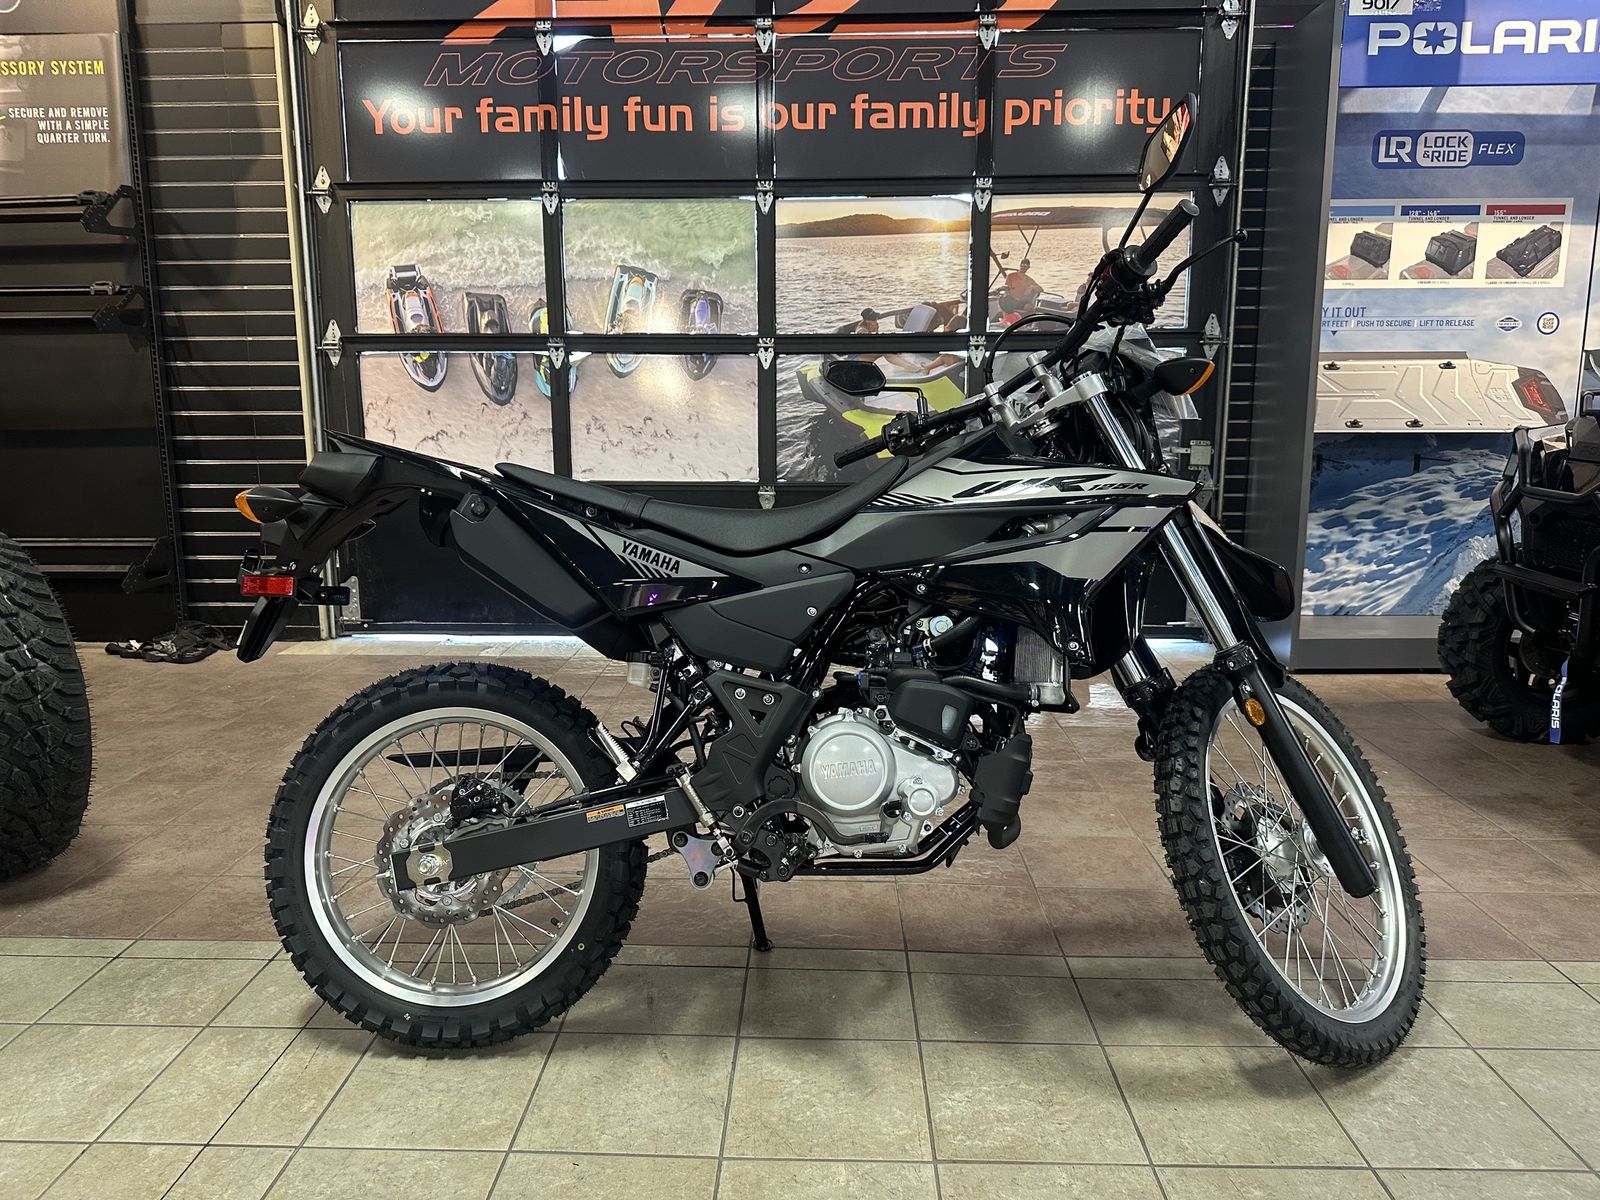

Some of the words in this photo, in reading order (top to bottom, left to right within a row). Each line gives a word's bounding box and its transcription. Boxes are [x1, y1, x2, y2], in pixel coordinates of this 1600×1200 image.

[1367, 18, 1600, 56] POLARI
[51, 60, 104, 76] SYSTEM
[424, 43, 1068, 87] MOTORSPORTS
[8, 107, 45, 118] SECURE
[48, 107, 67, 118] AND
[70, 107, 109, 118] REMOVE
[361, 98, 463, 135] Your
[475, 96, 609, 140] family
[624, 96, 693, 133] fun
[709, 96, 744, 133] is
[763, 100, 837, 131] our
[851, 92, 986, 137] family
[1004, 88, 1172, 135] priority
[38, 120, 62, 131] WITH
[65, 120, 72, 131] A
[75, 120, 110, 131] SIMPLE
[36, 132, 80, 144] QUARTER
[82, 132, 111, 144] TURN.
[1423, 136, 1468, 149] LOCK
[1478, 143, 1516, 155] FLEX
[1331, 307, 1342, 318] IT
[1344, 307, 1367, 318] OUT
[1419, 319, 1434, 327] LIFT
[1435, 319, 1444, 327] TO
[1445, 319, 1475, 327] RELEASE
[622, 540, 681, 575] YAMAHA
[1551, 677, 1568, 729] POLARIS
[820, 758, 877, 780] YAMAHA
